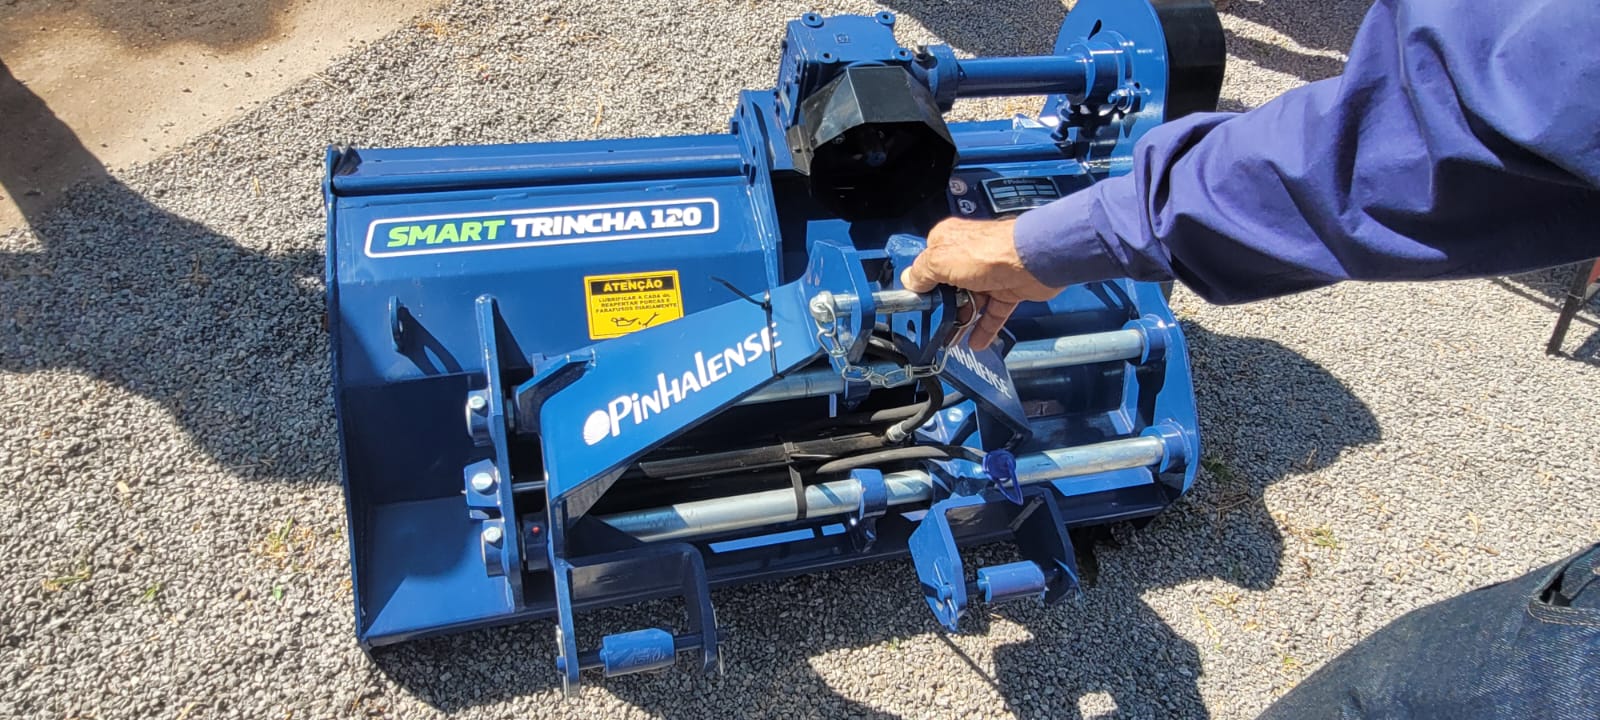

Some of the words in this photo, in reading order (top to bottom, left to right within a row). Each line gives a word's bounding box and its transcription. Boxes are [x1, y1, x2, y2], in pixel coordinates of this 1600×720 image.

[387, 219, 505, 248] SMART
[511, 210, 648, 239] TRINCHA
[651, 206, 702, 229] 120
[603, 278, 664, 293] ATENÇÃO
[598, 295, 636, 303] LUBRIFICAR
